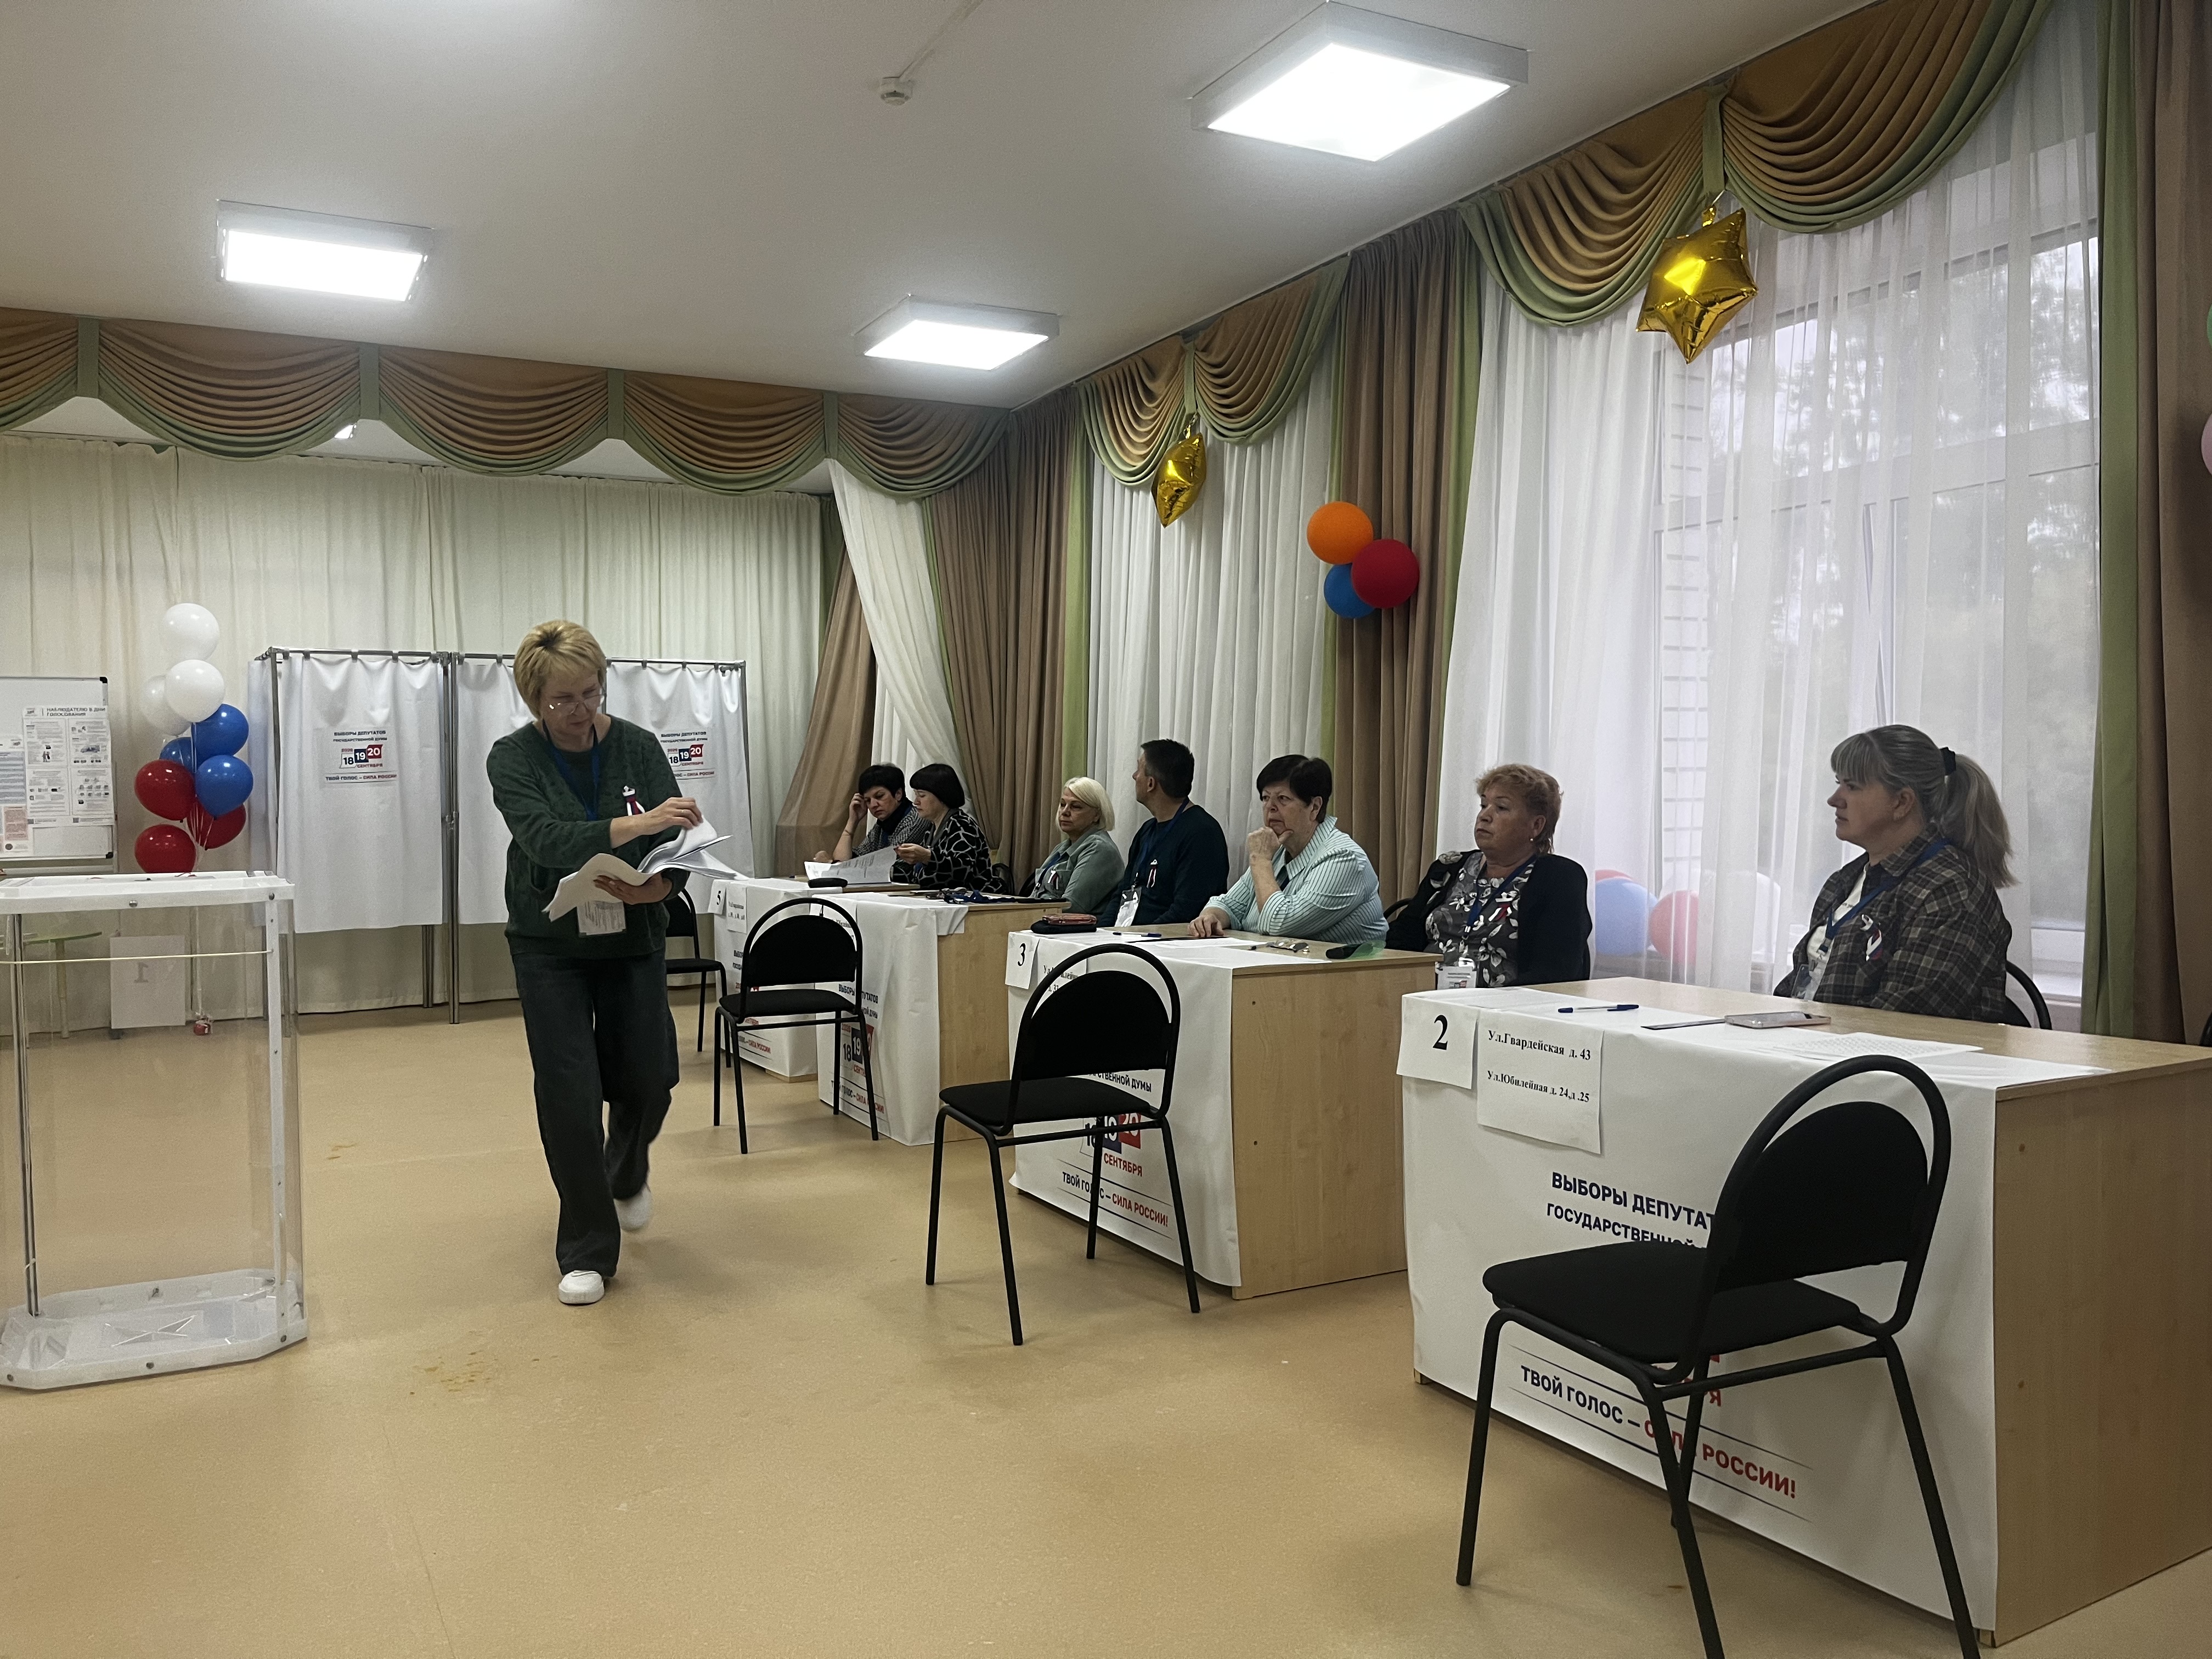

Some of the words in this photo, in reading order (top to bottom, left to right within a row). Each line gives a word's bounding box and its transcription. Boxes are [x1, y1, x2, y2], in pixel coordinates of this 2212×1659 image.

[343, 757, 354, 765] 18
[355, 752, 366, 760] 19
[367, 747, 381, 756] 20
[680, 751, 689, 759] 19
[690, 747, 702, 755] 20
[716, 890, 721, 905] 5
[1018, 943, 1026, 966] 3
[838, 983, 855, 996] ВЫБОРЫ
[1432, 1014, 1448, 1051] 2
[1488, 1030, 1565, 1056] Ул.Гвардейская
[1568, 1048, 1578, 1059] д.
[1579, 1048, 1591, 1060] 43
[843, 1043, 851, 1062] 18
[853, 1036, 861, 1056] 19
[1131, 1077, 1152, 1093] ДУМЫ
[1487, 1070, 1548, 1093] Ул.Юбилейная
[1549, 1087, 1557, 1096] д.
[1103, 1152, 1143, 1177] СЕНТЯБРЯ
[1062, 1171, 1080, 1188] ТВОЙ
[1081, 1180, 1104, 1199] ГОС
[1112, 1193, 1133, 1212] СИЛА
[1134, 1201, 1169, 1227] РОССИИ!
[1551, 1171, 1628, 1207] ВЫБОРЫ
[1632, 1193, 1715, 1230] ДЕПУТАТ
[1521, 1364, 1563, 1398] ТВОЙ
[1566, 1388, 1623, 1425] ГОЛОС
[1702, 1443, 1796, 1500] РОССИИ!
